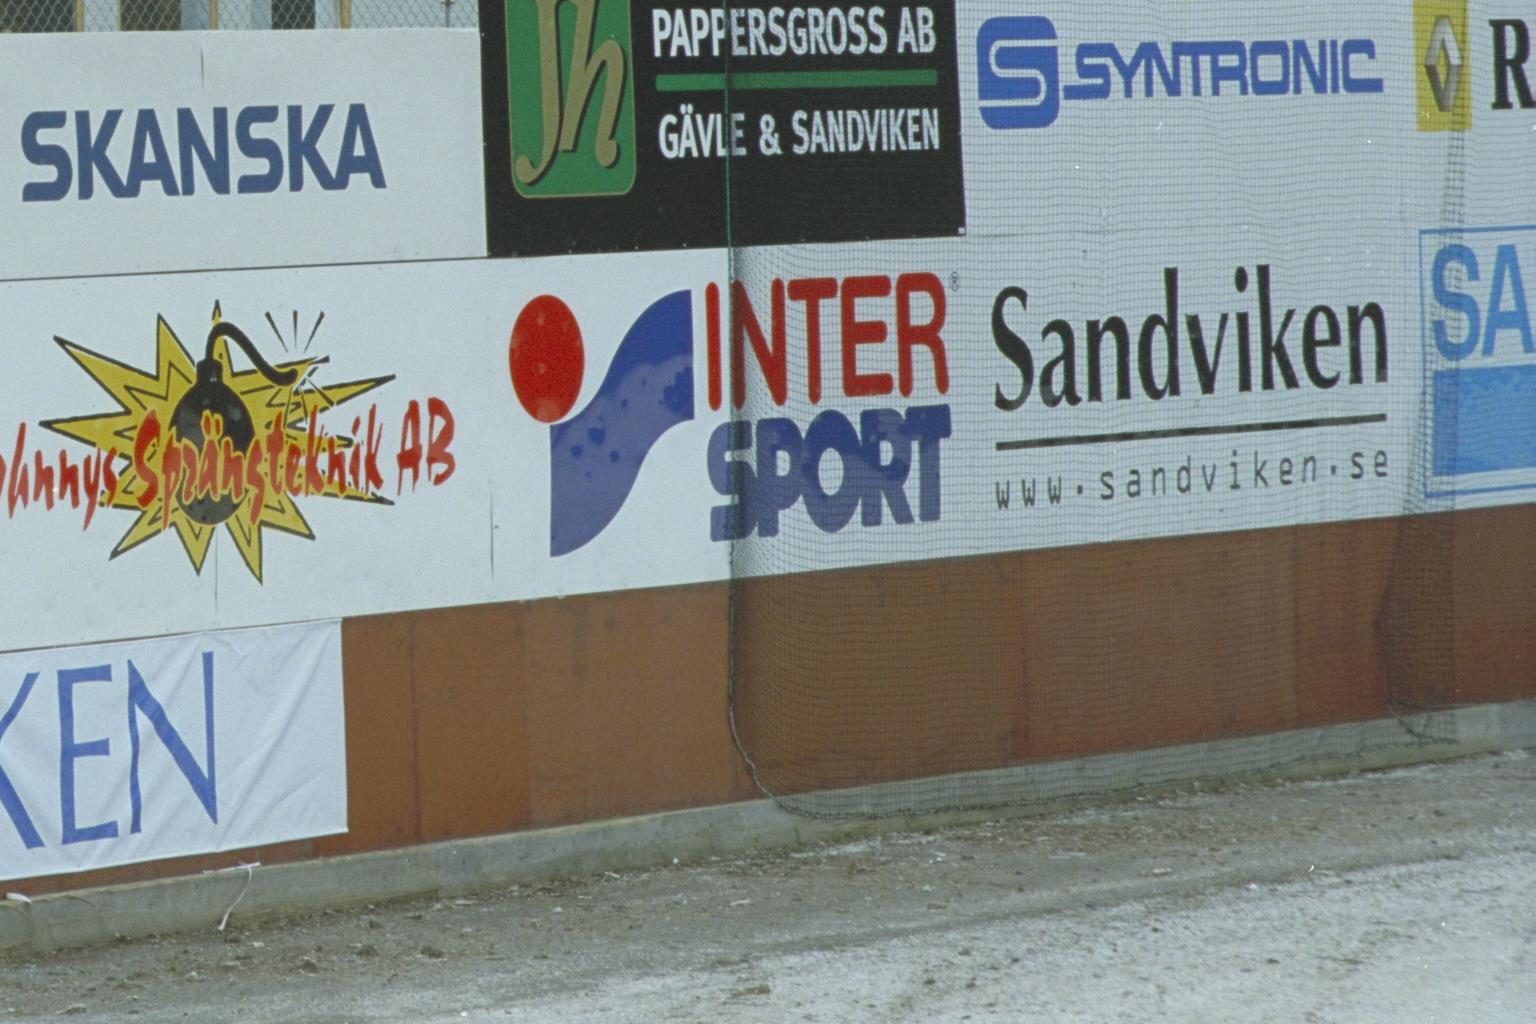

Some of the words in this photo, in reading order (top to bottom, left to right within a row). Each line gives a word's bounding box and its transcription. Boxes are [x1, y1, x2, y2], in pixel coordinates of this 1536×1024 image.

[652, 7, 887, 57] PAPPERSGROSS
[898, 7, 935, 53] AB
[1064, 39, 1383, 100] SYNTRONIC
[21, 103, 387, 202] SKANSKA
[658, 105, 746, 159] GÄVLE
[760, 112, 781, 155] &
[792, 108, 940, 153] SANDVIKEN
[705, 272, 949, 411] INTER
[991, 264, 1388, 412] Sandviken
[395, 397, 455, 496] AB
[707, 404, 951, 542] SPORT
[997, 449, 1388, 510] www.sandviken.se
